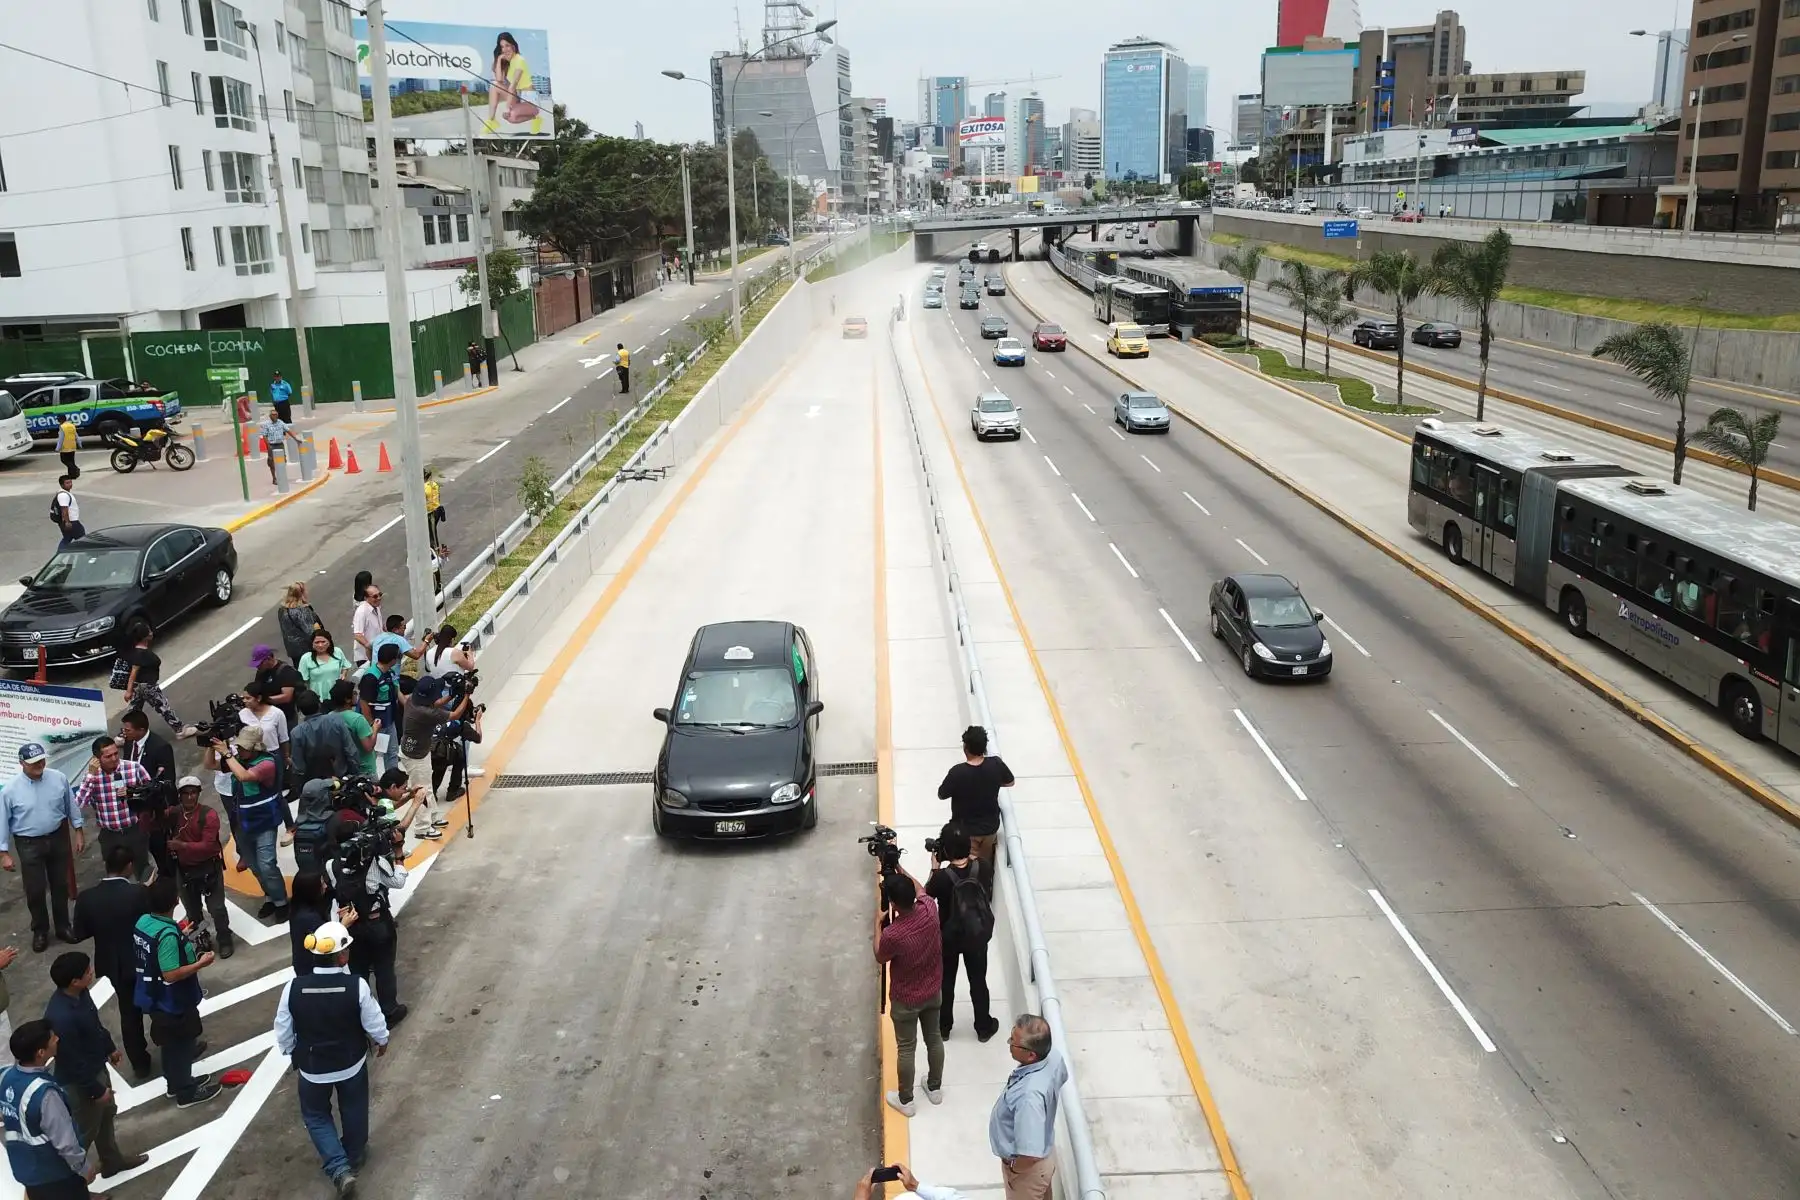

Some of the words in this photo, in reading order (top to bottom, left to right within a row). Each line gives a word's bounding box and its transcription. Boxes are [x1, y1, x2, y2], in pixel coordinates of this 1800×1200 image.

[960, 122, 1004, 134] EXITOSA
[145, 343, 203, 356] COCHERA
[209, 340, 263, 353] COCHERA
[1618, 600, 1680, 646] Metropolitano
[63, 716, 82, 728] Orué
